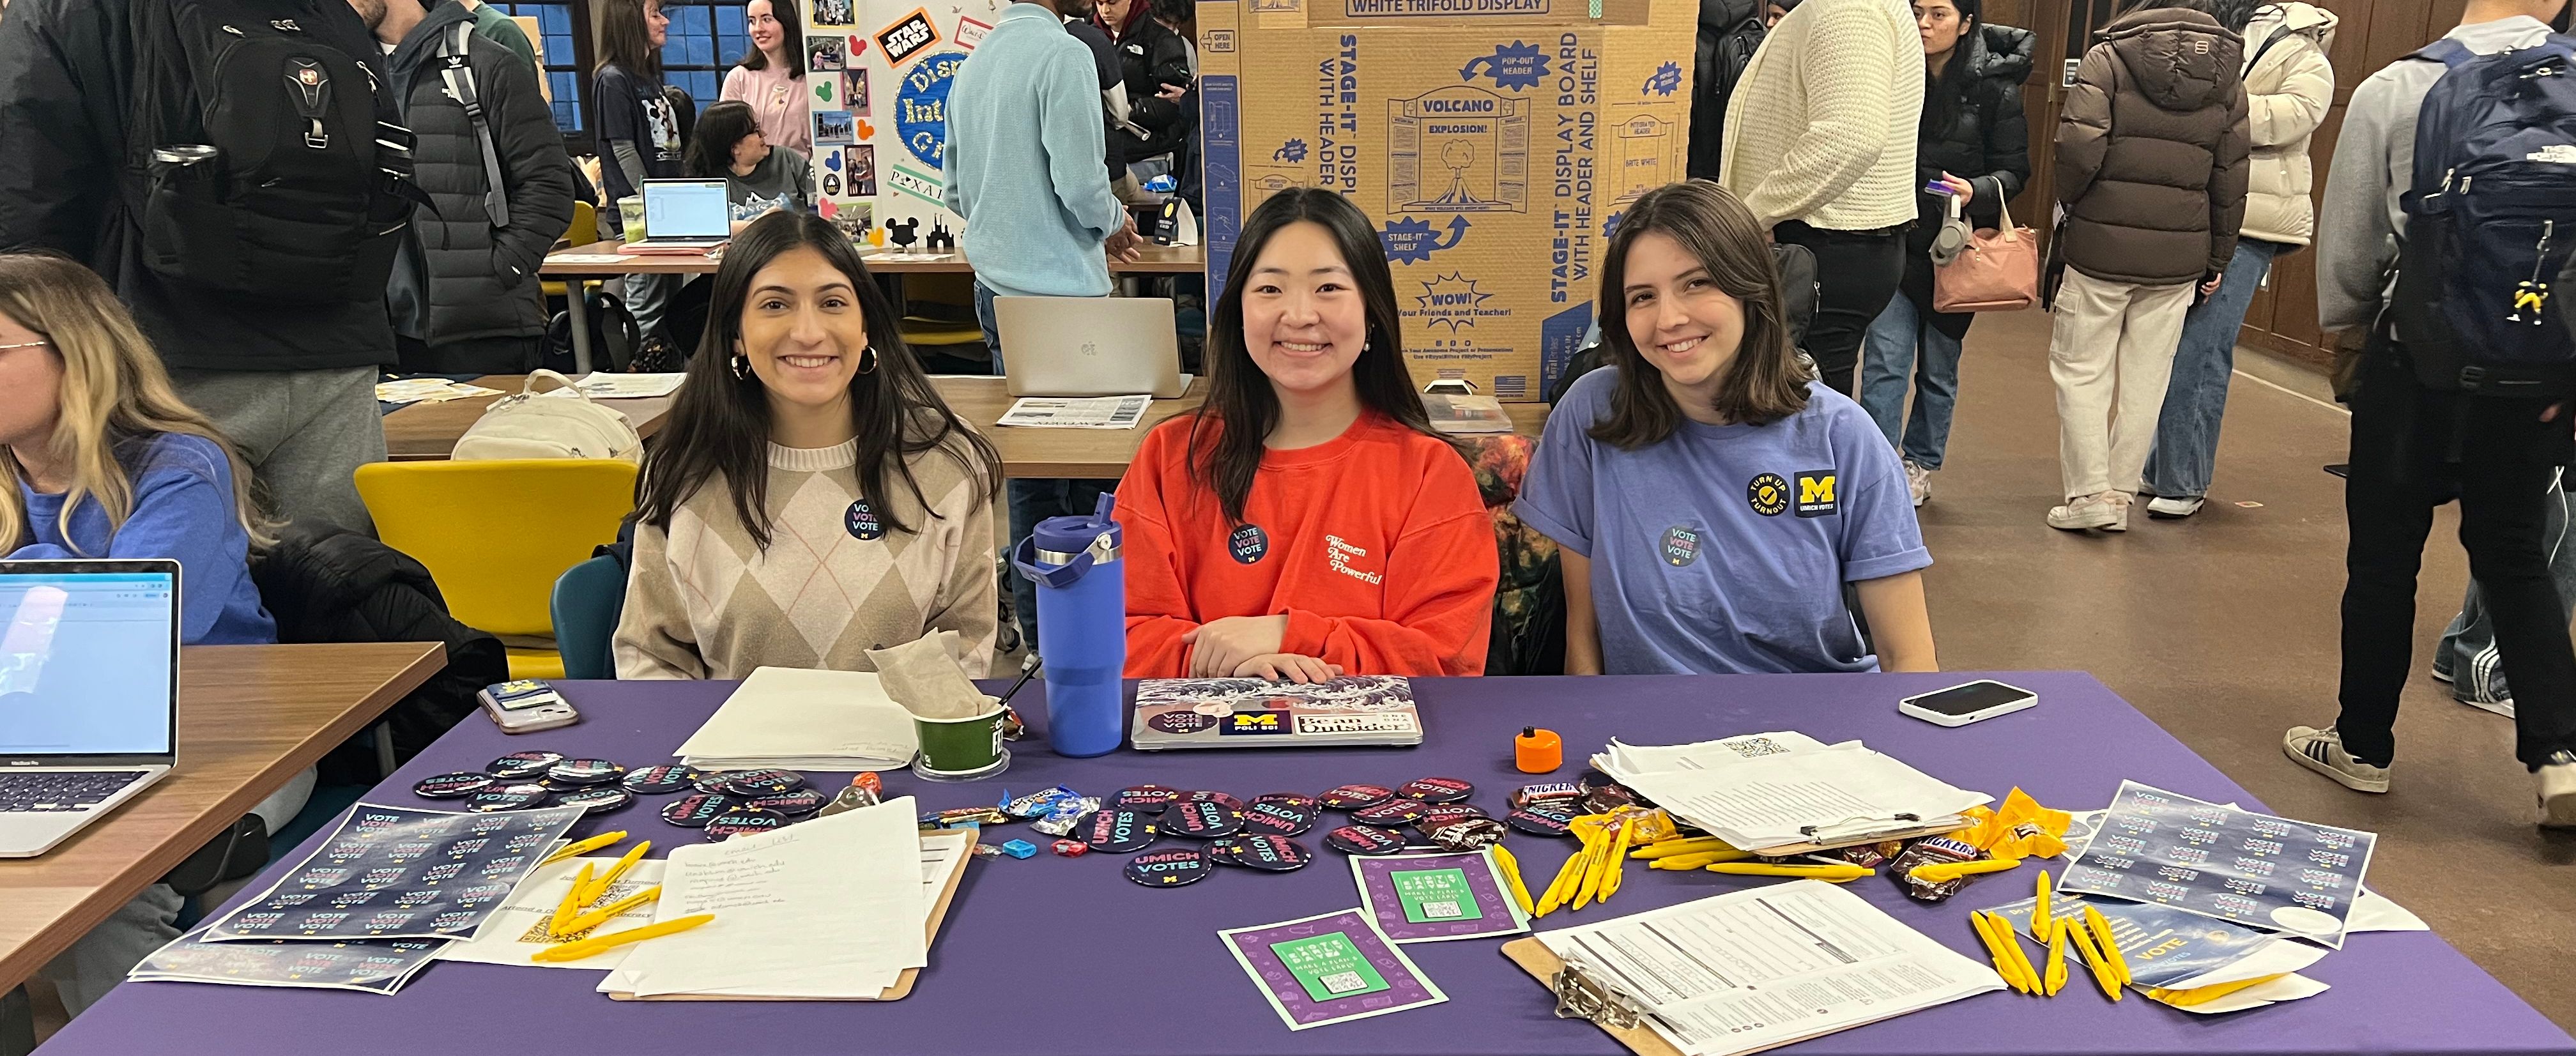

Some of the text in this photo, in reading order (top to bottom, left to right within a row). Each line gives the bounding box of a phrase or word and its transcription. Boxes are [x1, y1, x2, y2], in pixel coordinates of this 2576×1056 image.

[1353, 0, 1541, 12] WHITE TRIFOLD DISPLAY
[885, 20, 926, 49] STAR
[887, 26, 929, 57] WARS
[1501, 56, 1534, 66] POP-OUT
[1503, 66, 1533, 75] HEADER
[1558, 33, 1577, 106] BOARD
[1423, 100, 1494, 113] VOLCANO
[1319, 58, 1335, 185] WITH HEADER
[1429, 125, 1487, 134] EXPLOSION!
[1555, 113, 1574, 198] DISPLAY
[1574, 49, 1597, 281] WITH HEADER AND SHELF
[1393, 243, 1417, 251] SHELF
[1432, 293, 1472, 306] WOW!
[1750, 475, 1786, 493] TURN UP
[1800, 476, 1836, 503] M
[854, 504, 869, 512] VO
[1751, 497, 1786, 515] TURNOUT
[852, 521, 878, 531] VOTE
[1234, 527, 1258, 540] VOTE
[1671, 528, 1696, 542] VOTE
[1235, 535, 1260, 548] VOTE
[1325, 534, 1367, 557] Women
[1669, 536, 1694, 551] VOTE
[1237, 544, 1262, 556] VOTE
[1328, 546, 1350, 563] Are
[1667, 545, 1692, 559] VOTE
[1330, 559, 1383, 585] Powerful
[1234, 714, 1278, 726] M
[746, 776, 794, 789] VOTE
[1410, 782, 1457, 795] VOTES
[476, 793, 530, 802] VOTES
[1330, 788, 1375, 801] VOTES
[2136, 791, 2170, 804] VOTE
[673, 795, 704, 820] UMICH
[693, 795, 725, 820] VOTES
[1254, 802, 1303, 823] VOTES
[1368, 801, 1418, 818] VOTES
[365, 813, 399, 822] VOTE
[719, 816, 778, 827] VOTES
[1179, 802, 1204, 831] UMICH
[1200, 802, 1223, 830] VOTES
[1245, 810, 1296, 832] UMICH
[1510, 809, 1567, 831] UMICH
[1114, 811, 1134, 844] VOTES
[1333, 827, 1379, 850] UMICH
[1352, 825, 1392, 846] VOTES
[2246, 838, 2283, 847] VOTE
[1250, 835, 1278, 862] VOTES
[1269, 835, 1300, 862] UMICH
[491, 855, 525, 864] VOTE
[1135, 852, 1200, 864] UMICH
[2237, 856, 2276, 867] VOTE
[481, 866, 516, 875] VOTE
[1137, 861, 1200, 873] VOTES
[2300, 877, 2339, 888] VOTE
[2218, 894, 2258, 906] VOTE
[2135, 937, 2188, 961] VOTE
